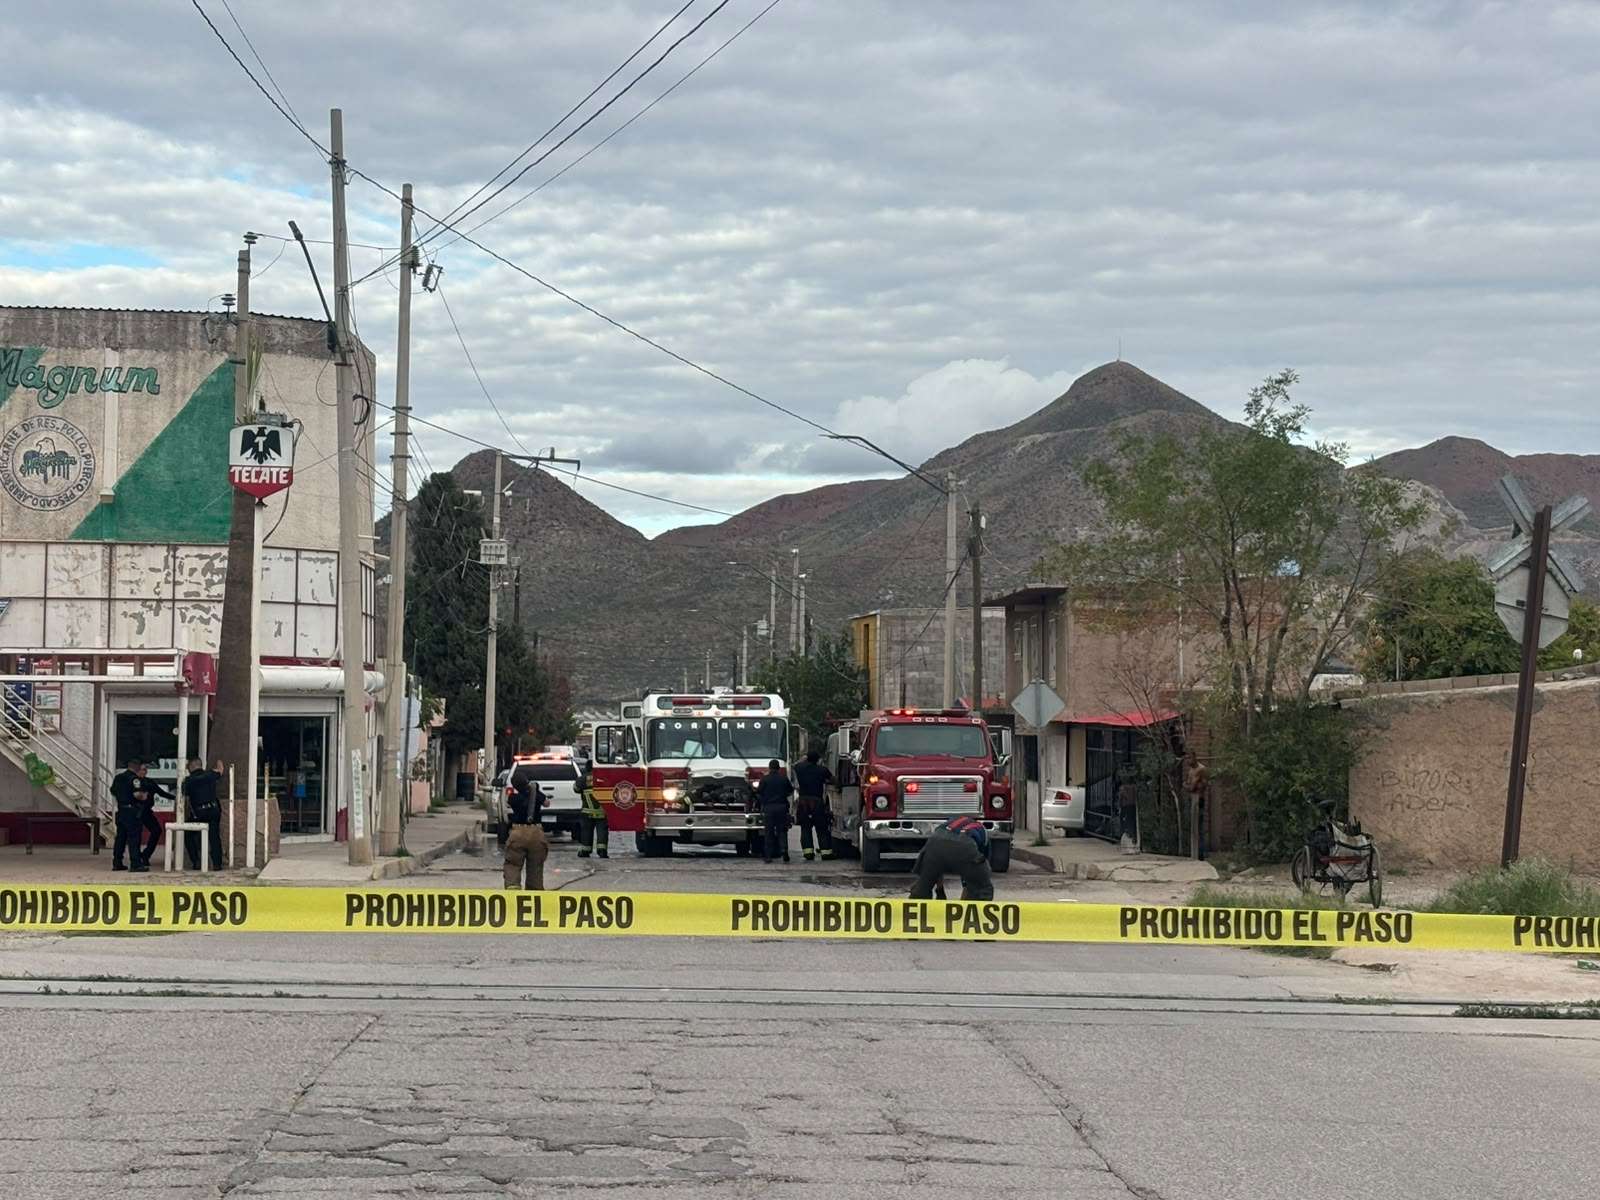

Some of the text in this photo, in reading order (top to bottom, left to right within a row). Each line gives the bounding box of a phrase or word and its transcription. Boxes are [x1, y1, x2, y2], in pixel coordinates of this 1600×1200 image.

[0, 348, 160, 409] Magnum
[22, 421, 34, 432] DE
[230, 466, 290, 484] TECATE
[129, 891, 162, 925] EL
[172, 891, 248, 926] PASO
[345, 893, 634, 929] PROHIBIDO EL PASO
[731, 899, 1020, 935] PROHIBIDO EL PASO
[1120, 907, 1413, 944] PROHIBIDO EL PASO
[1514, 916, 1600, 948] PROH
